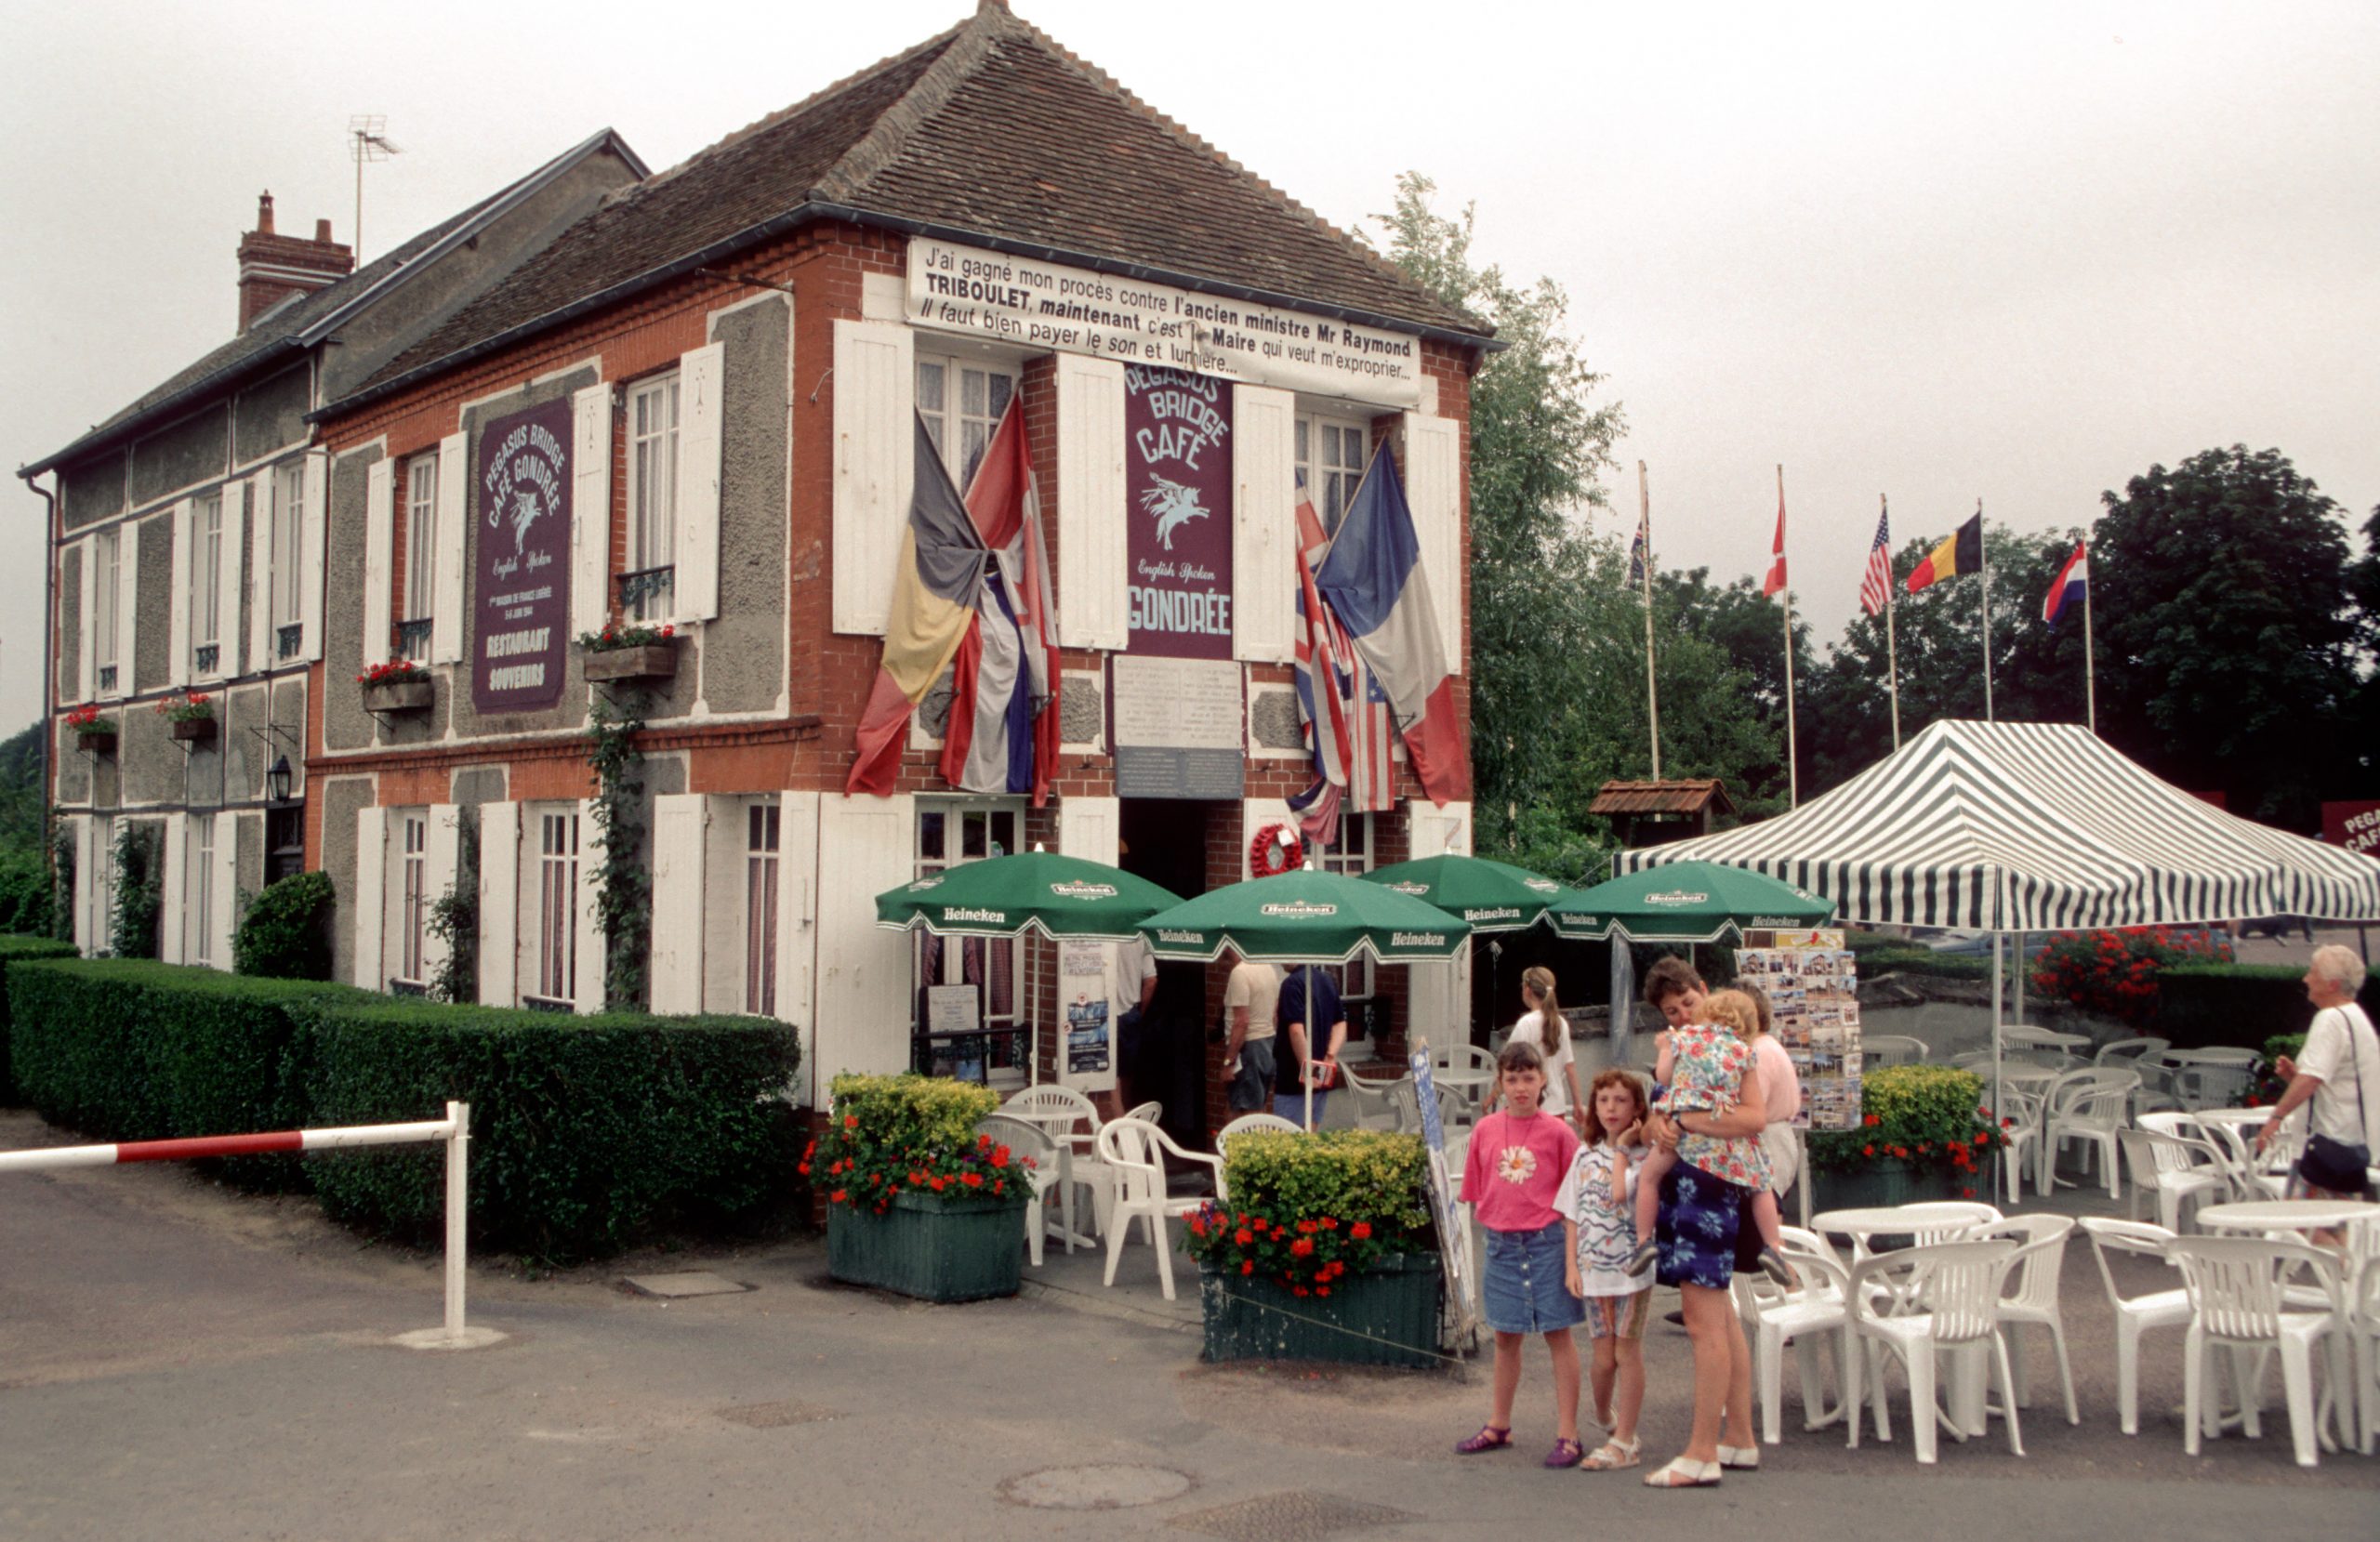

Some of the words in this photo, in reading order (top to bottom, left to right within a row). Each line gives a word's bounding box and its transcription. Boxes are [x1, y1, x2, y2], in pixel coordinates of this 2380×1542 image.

[926, 247, 955, 270] J'ai
[961, 258, 1012, 282] gagné
[1019, 272, 1053, 290] mon
[1060, 279, 1114, 303] procès
[1119, 290, 1168, 311] contre
[1174, 297, 1238, 325] l'ancien
[1245, 314, 1311, 338] ministre
[1316, 323, 1336, 345] Mr
[1342, 329, 1411, 357] Raymond
[926, 273, 1033, 313] TRIBOULET,
[1039, 299, 1141, 331] maintenant
[1147, 318, 1183, 338] c'est
[1212, 327, 1256, 351] Maire
[1262, 340, 1283, 358] qui
[1288, 345, 1316, 363] veut
[1321, 351, 1411, 380] m'exproprier...
[939, 302, 975, 325] faut
[984, 310, 1022, 335] bien
[1029, 324, 1079, 346] payer
[1087, 328, 1101, 349] le
[1108, 337, 1138, 355] son
[1144, 344, 1162, 359] et
[1147, 391, 1229, 447] BRIDGE
[485, 425, 527, 493] PEGASUS
[530, 424, 565, 474] BRIDGE
[1136, 424, 1208, 471] CAFÉ
[489, 467, 512, 528] CAFÉ
[514, 455, 561, 517] GONDRÉE
[492, 556, 518, 581] English
[1137, 559, 1175, 580] English
[1179, 563, 1216, 585] Spoken
[1128, 588, 1232, 636] GONDRÉE
[486, 627, 550, 658] RESTAURANT
[489, 663, 545, 691] SOUVENIRS
[945, 907, 1005, 923] Heineken
[1464, 908, 1520, 921] Heineken
[1561, 914, 1598, 926] Heineken
[1752, 916, 1801, 928] Heineken
[1157, 929, 1204, 944] Heineken
[1391, 931, 1446, 946] Heineken
